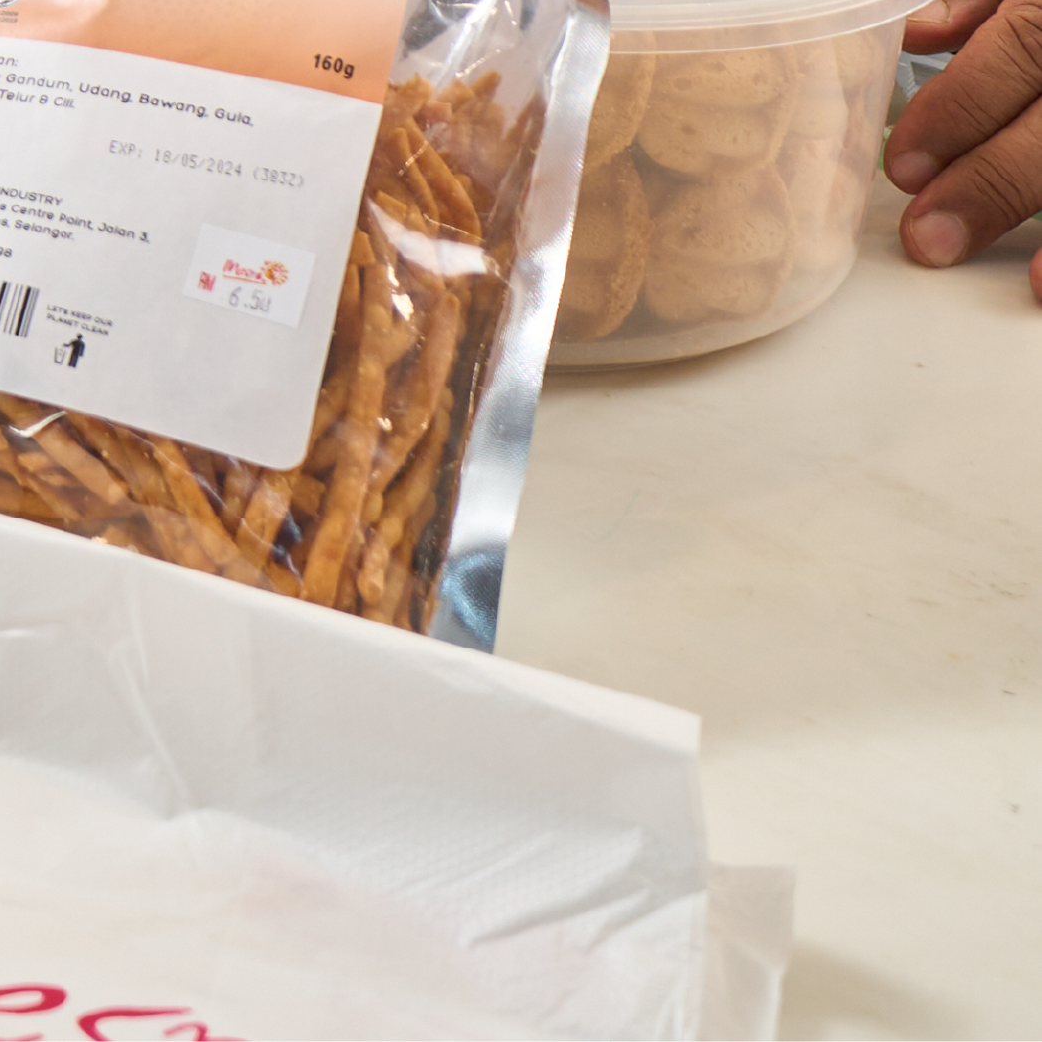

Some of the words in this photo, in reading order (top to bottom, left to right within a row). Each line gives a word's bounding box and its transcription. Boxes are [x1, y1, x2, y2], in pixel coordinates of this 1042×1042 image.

[314, 53, 355, 79] 160g
[0, 88, 35, 103] Telur
[109, 139, 143, 159] EXP:
[154, 148, 243, 177] 18/05/2024
[11, 203, 55, 220] Centre
[98, 222, 136, 240] Jalan
[14, 219, 75, 241] Selangor.
